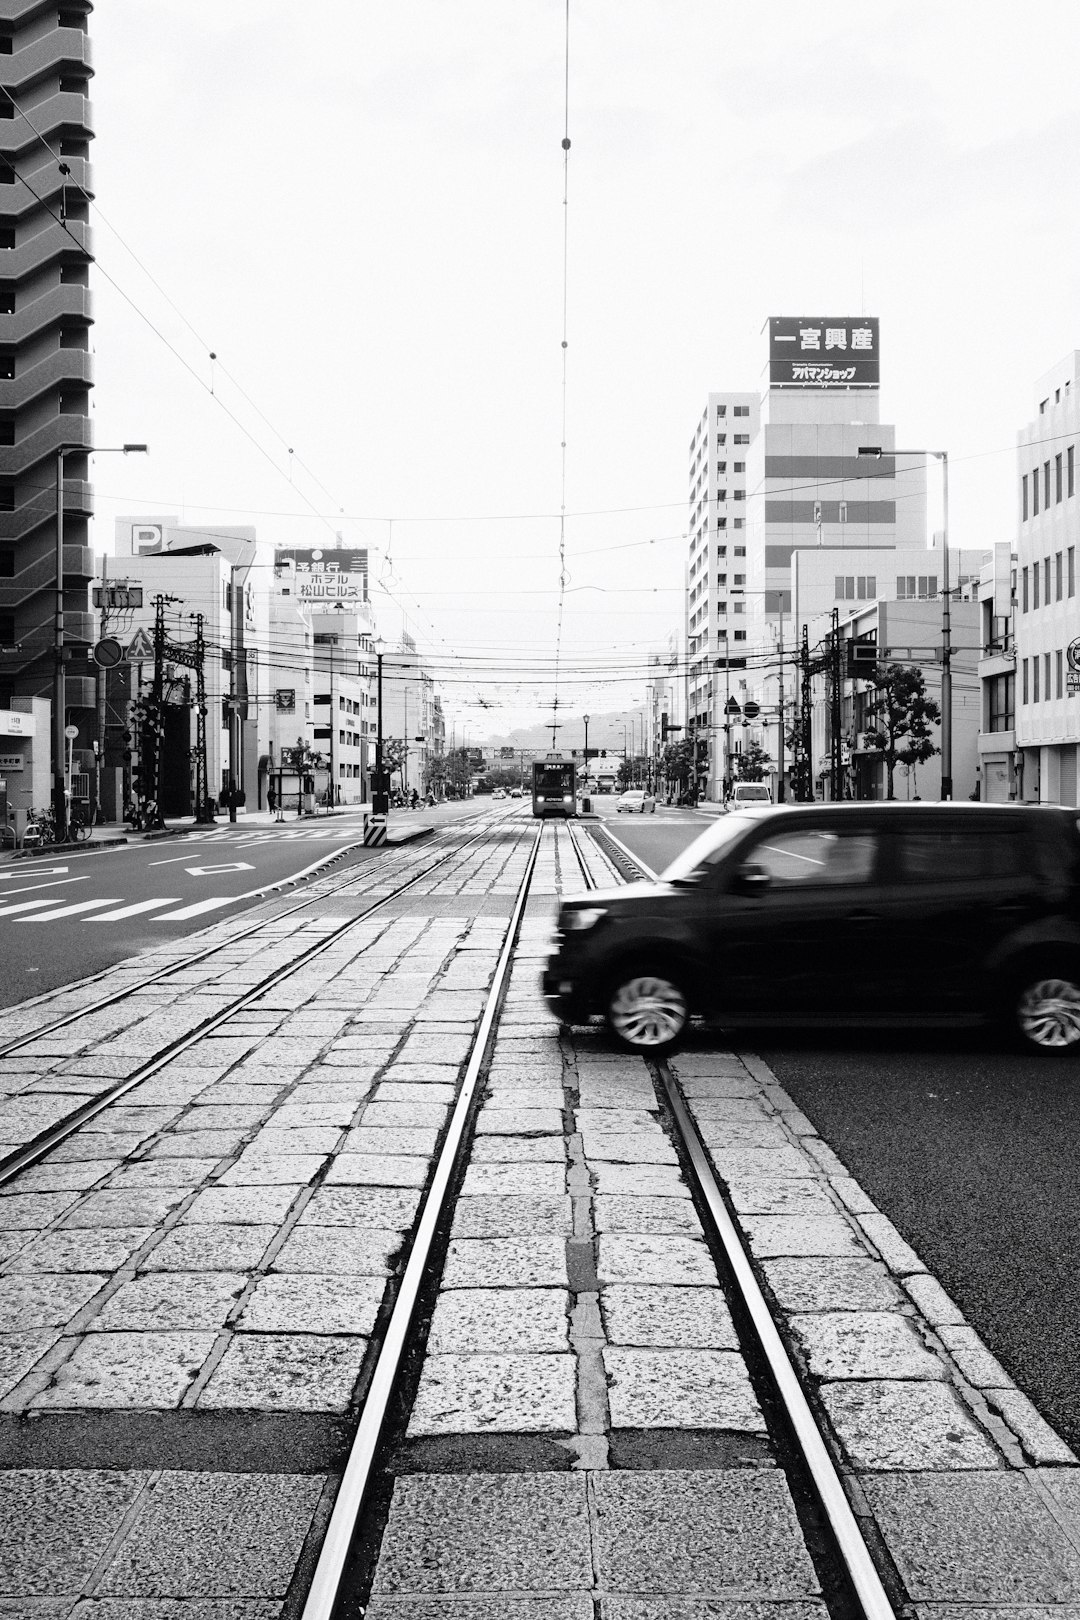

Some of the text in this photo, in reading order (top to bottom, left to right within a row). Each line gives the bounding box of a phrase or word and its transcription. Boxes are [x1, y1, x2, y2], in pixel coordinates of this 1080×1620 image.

[774, 327, 873, 350] 一宮興産
[791, 366, 857, 380] アパマンショップ
[132, 525, 161, 555] P
[311, 574, 349, 584] ホテル
[1067, 674, 1080, 683] 広告
